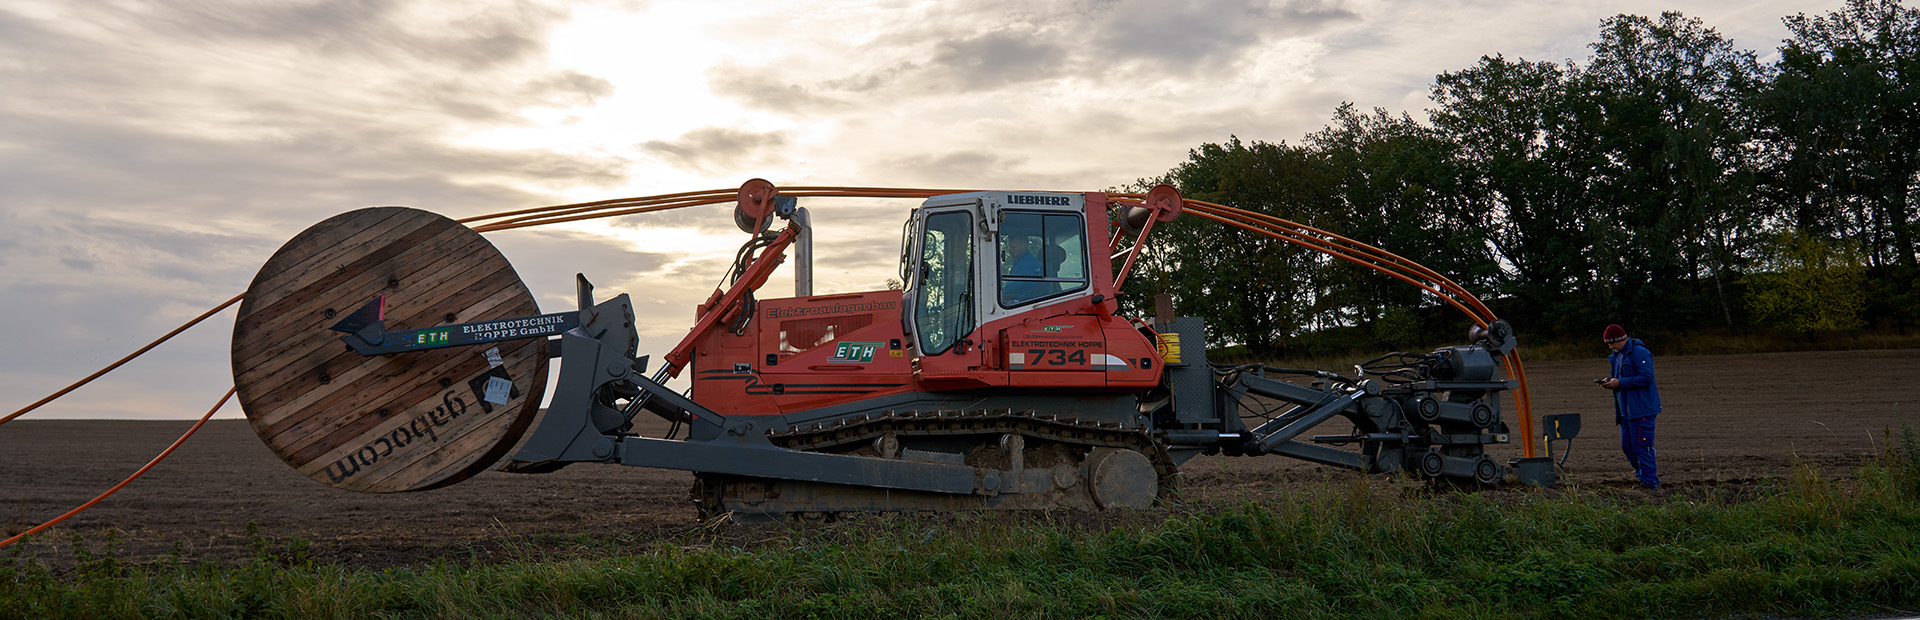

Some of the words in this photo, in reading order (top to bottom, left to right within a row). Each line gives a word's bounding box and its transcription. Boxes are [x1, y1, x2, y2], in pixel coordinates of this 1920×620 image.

[1007, 194, 1070, 206] LIEBHERR
[766, 301, 896, 319] Elektroanlagenbau
[463, 316, 564, 334] ELEKTROTECHNIK
[520, 325, 556, 335] GmbH
[418, 331, 449, 344] ETH
[837, 346, 875, 358] ETH
[1028, 349, 1086, 366] 734
[325, 390, 467, 483] gabocom
